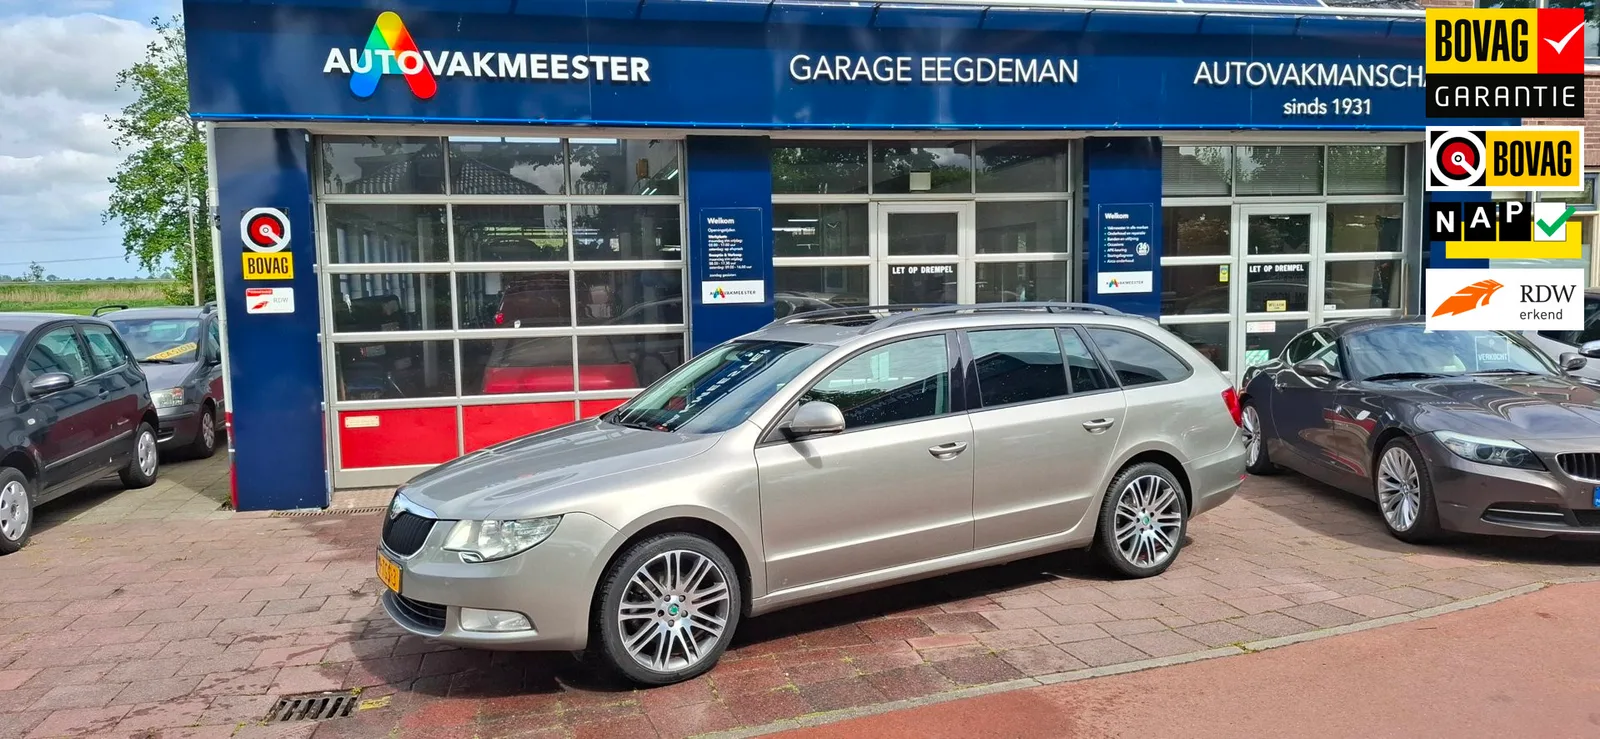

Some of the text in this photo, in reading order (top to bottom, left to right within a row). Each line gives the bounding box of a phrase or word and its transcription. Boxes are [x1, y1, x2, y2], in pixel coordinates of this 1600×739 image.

[323, 47, 651, 82] AUTOVAKMEESTER
[789, 54, 1078, 83] GARAGE EEGDEMAN
[1193, 61, 1426, 88] AUTOVAKMANSCH
[1283, 97, 1371, 115] sinds 1931
[247, 257, 289, 274] BOVAG
[892, 265, 954, 275] LET OP DREMPEL
[1249, 264, 1305, 273] LET OP DREMPEL
[1477, 353, 1509, 361] VERKOCHT
